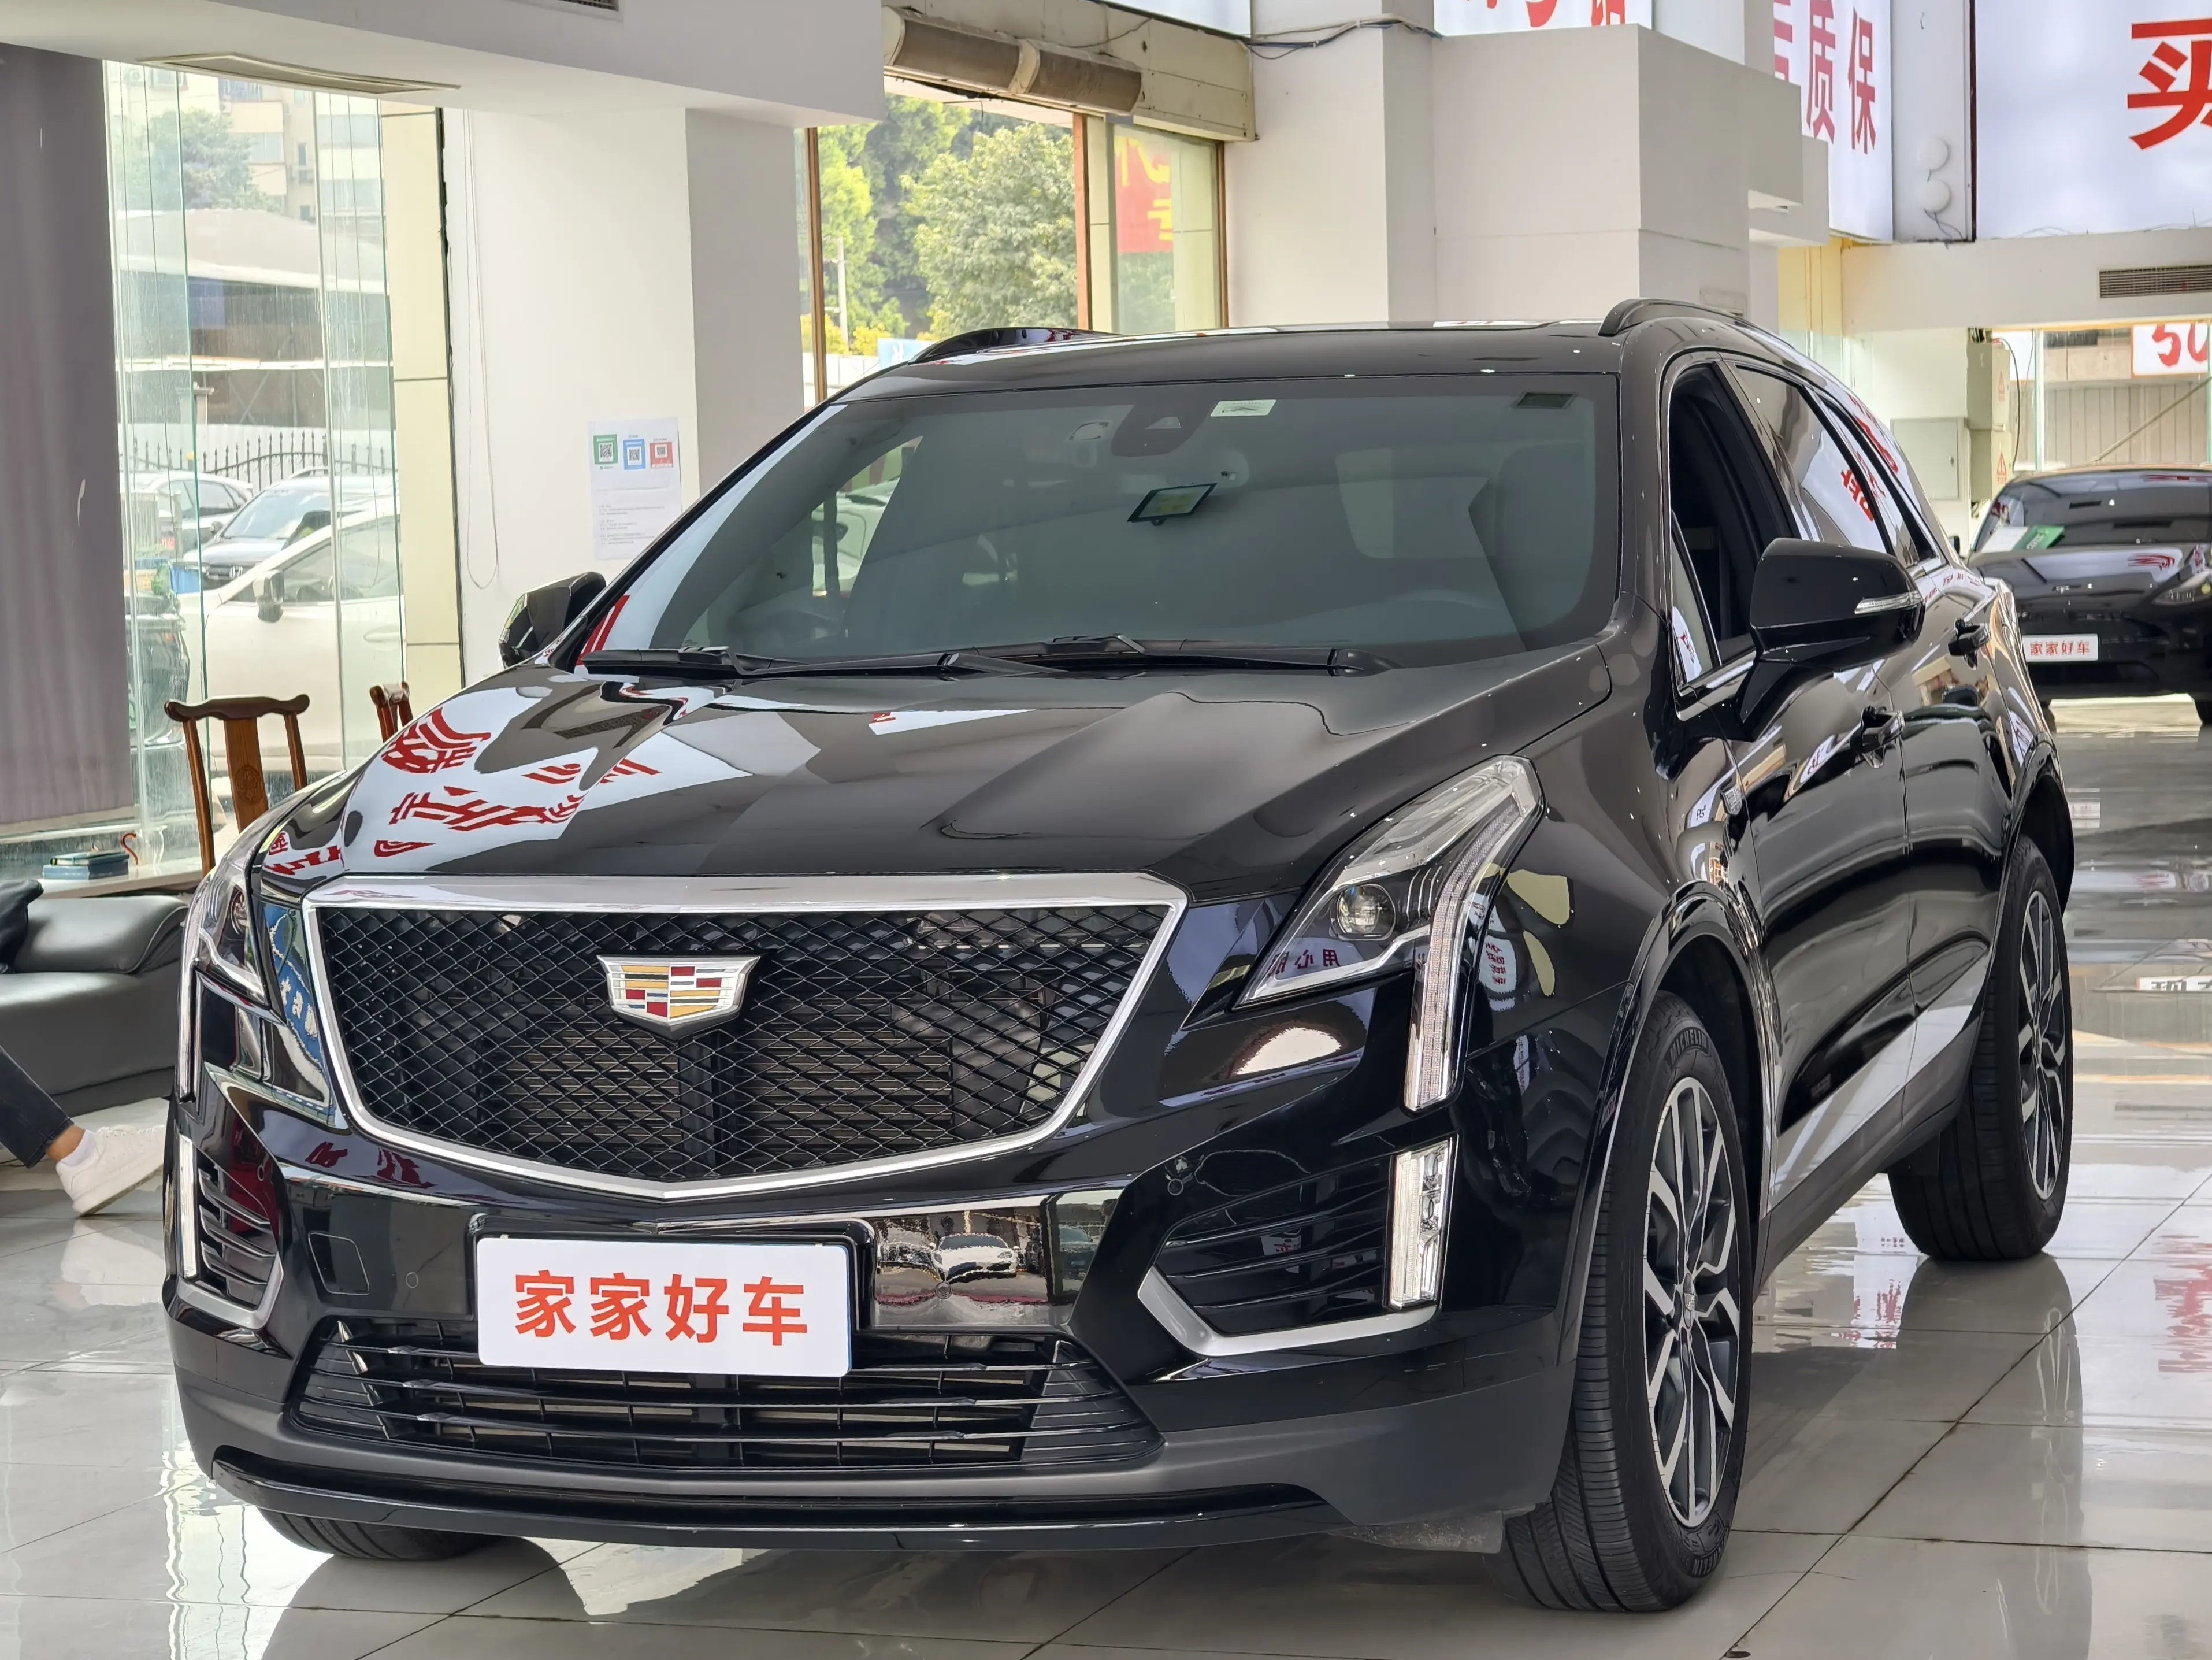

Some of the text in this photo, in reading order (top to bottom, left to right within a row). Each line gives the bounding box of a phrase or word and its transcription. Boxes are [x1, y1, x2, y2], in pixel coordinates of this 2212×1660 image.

[2029, 640, 2090, 656] 家家好车
[1669, 1028, 1709, 1065] MICHELIN
[515, 1270, 807, 1346] 家家好车
